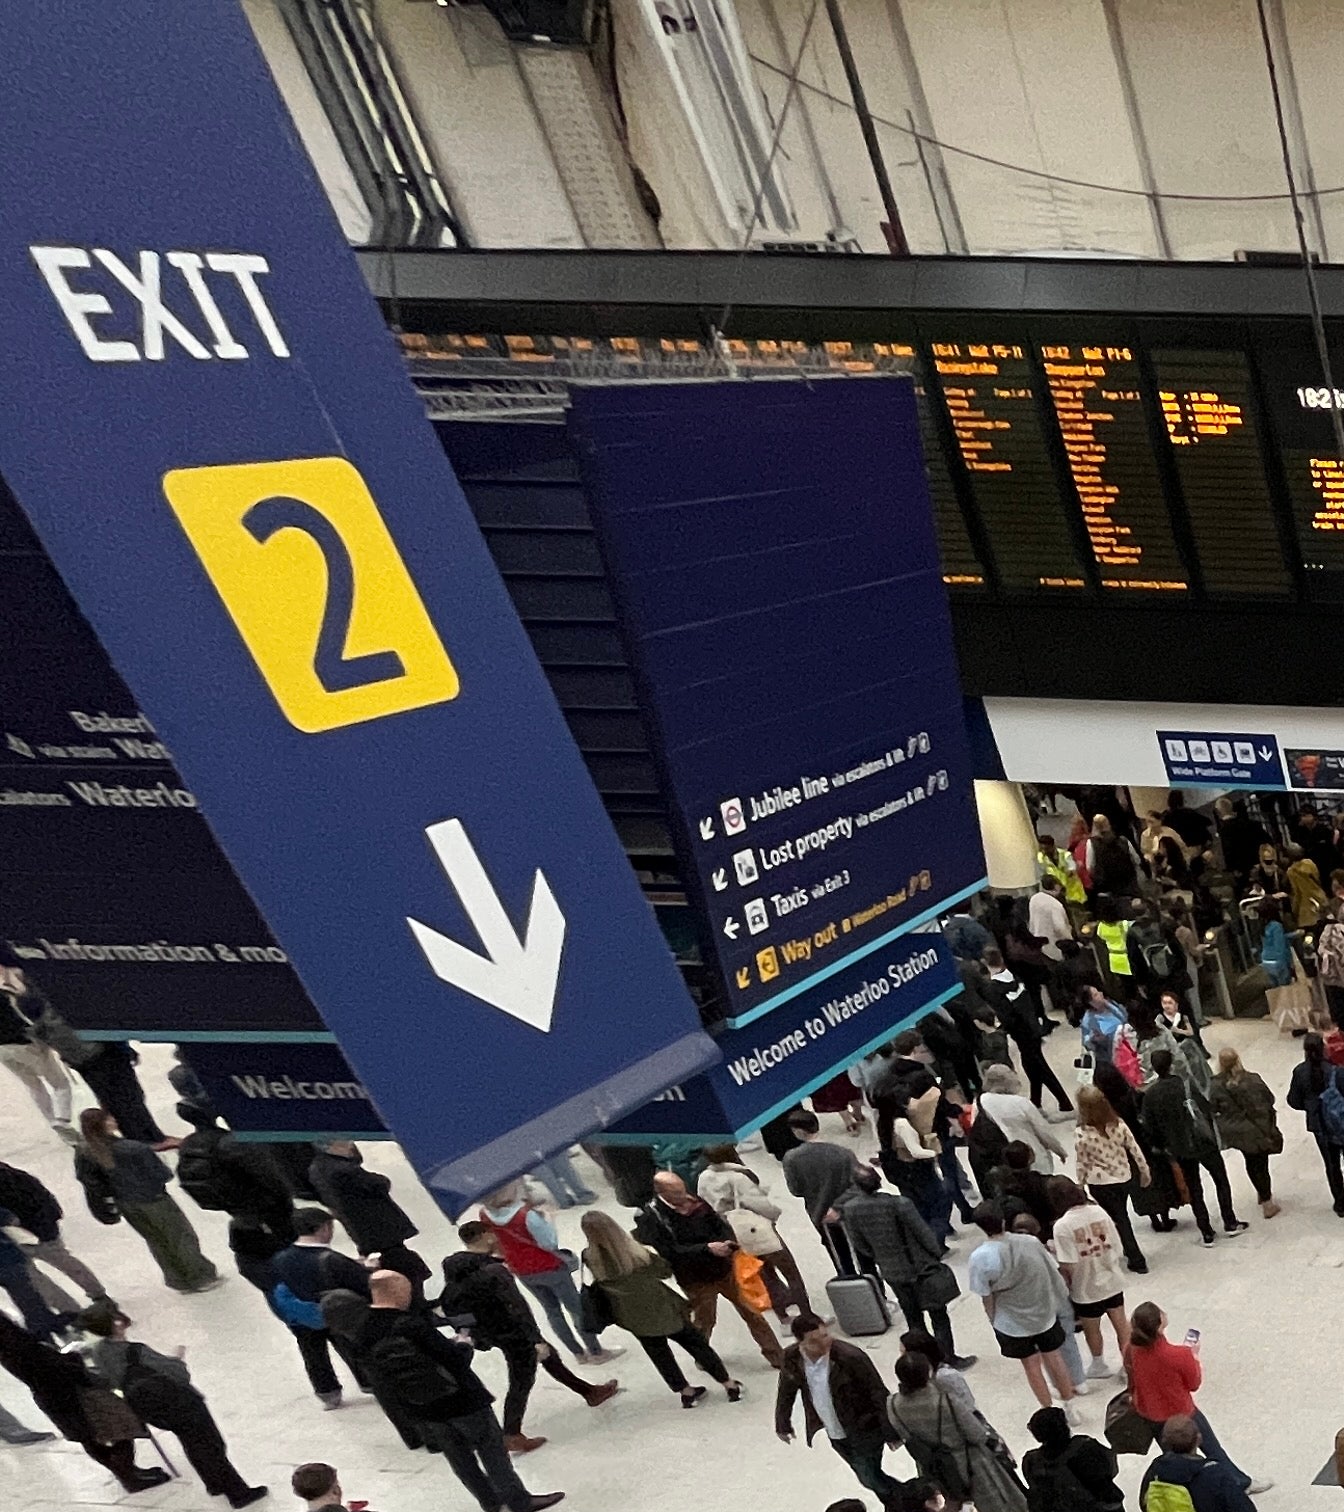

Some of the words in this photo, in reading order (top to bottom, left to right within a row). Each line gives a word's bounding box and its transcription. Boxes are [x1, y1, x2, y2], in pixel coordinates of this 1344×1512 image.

[29, 246, 291, 361] EXIT
[240, 494, 407, 693] 2
[750, 786, 802, 822] Jubilee
[801, 775, 830, 801] line
[759, 839, 796, 870] Lost
[796, 815, 853, 860] property
[770, 886, 809, 917] Taxis
[40, 938, 216, 962] Information
[213, 943, 241, 962] &
[780, 935, 812, 965] Way
[814, 922, 838, 948] out
[727, 1030, 807, 1086] Welcome
[804, 1018, 826, 1040] to
[821, 976, 890, 1028] Waterloo
[888, 948, 938, 988] Station
